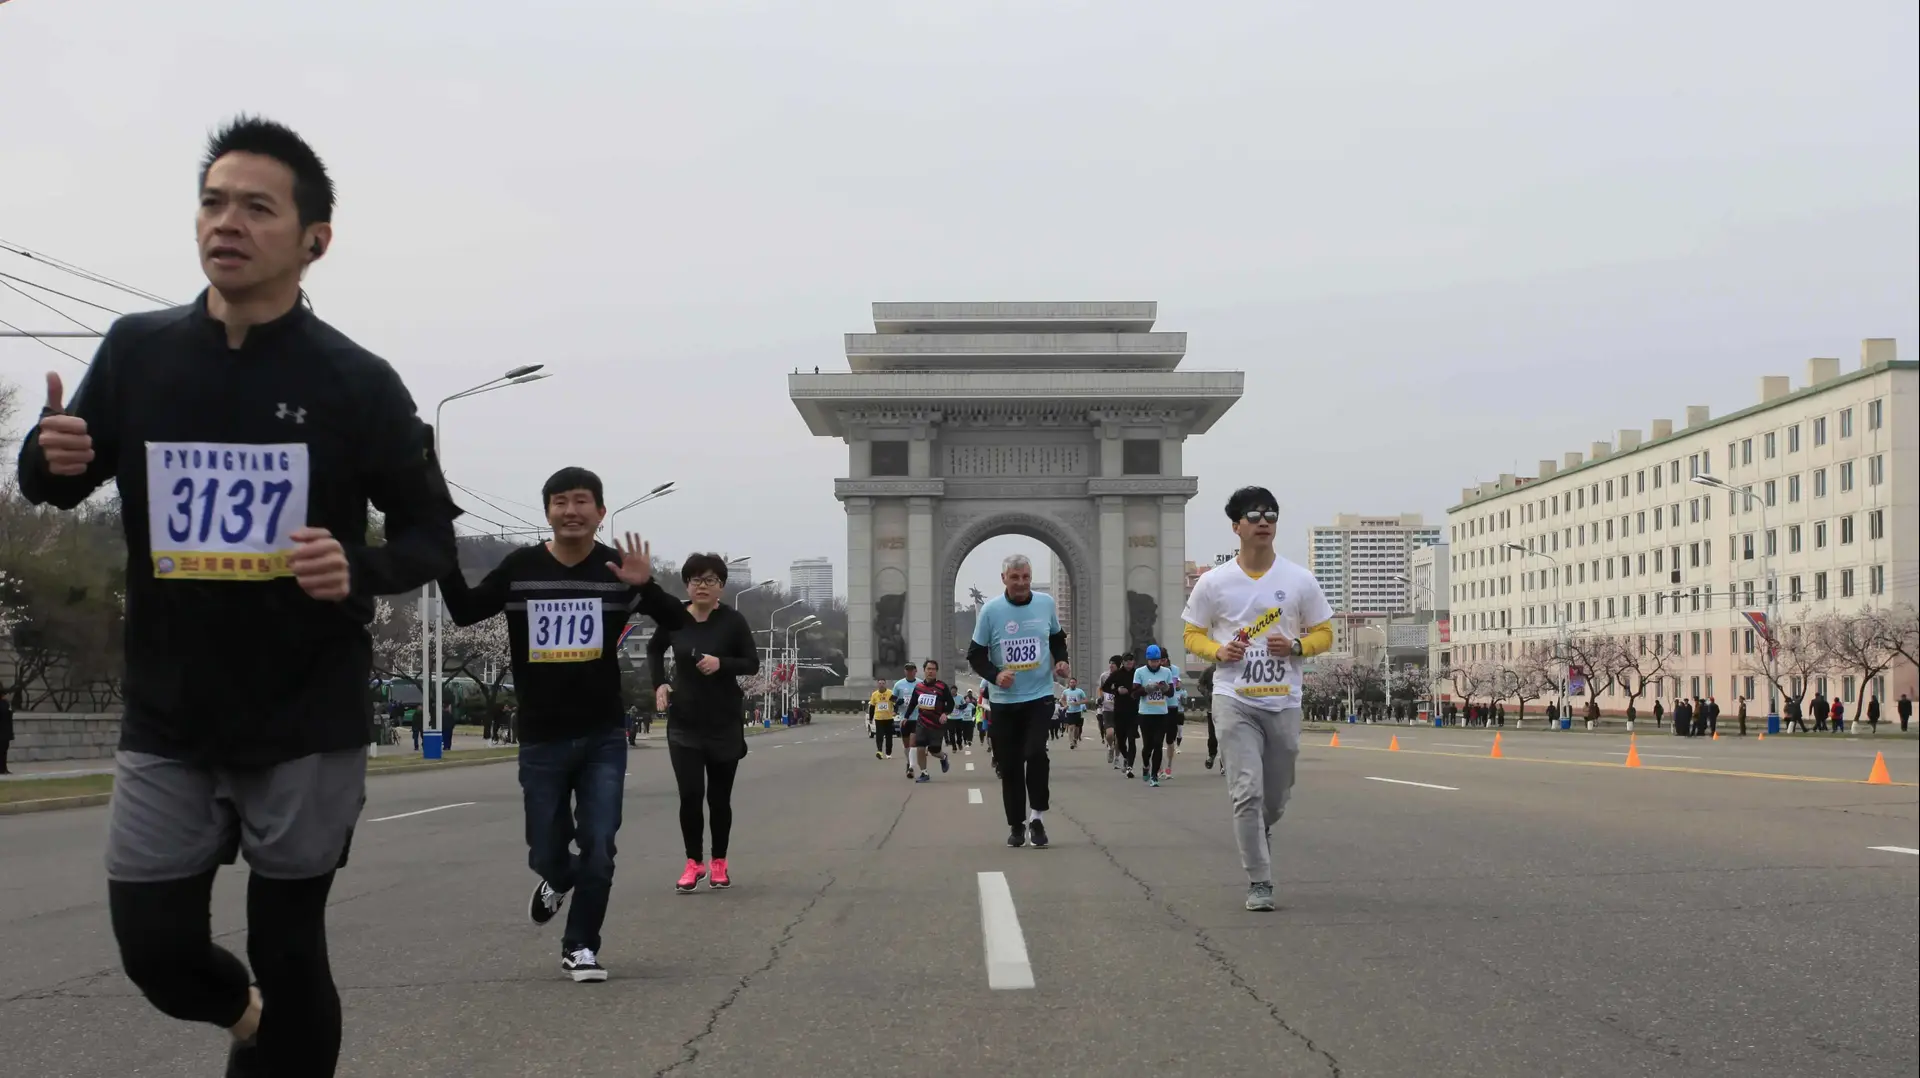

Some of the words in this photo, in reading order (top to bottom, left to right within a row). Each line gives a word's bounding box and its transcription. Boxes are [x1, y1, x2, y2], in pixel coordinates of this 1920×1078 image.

[164, 449, 289, 471] PYONGYANG
[168, 477, 292, 544] 3137
[535, 602, 593, 612] PYONGYANG
[536, 614, 594, 645] 3119
[1006, 645, 1036, 662] 3038
[1241, 659, 1285, 683] 4035
